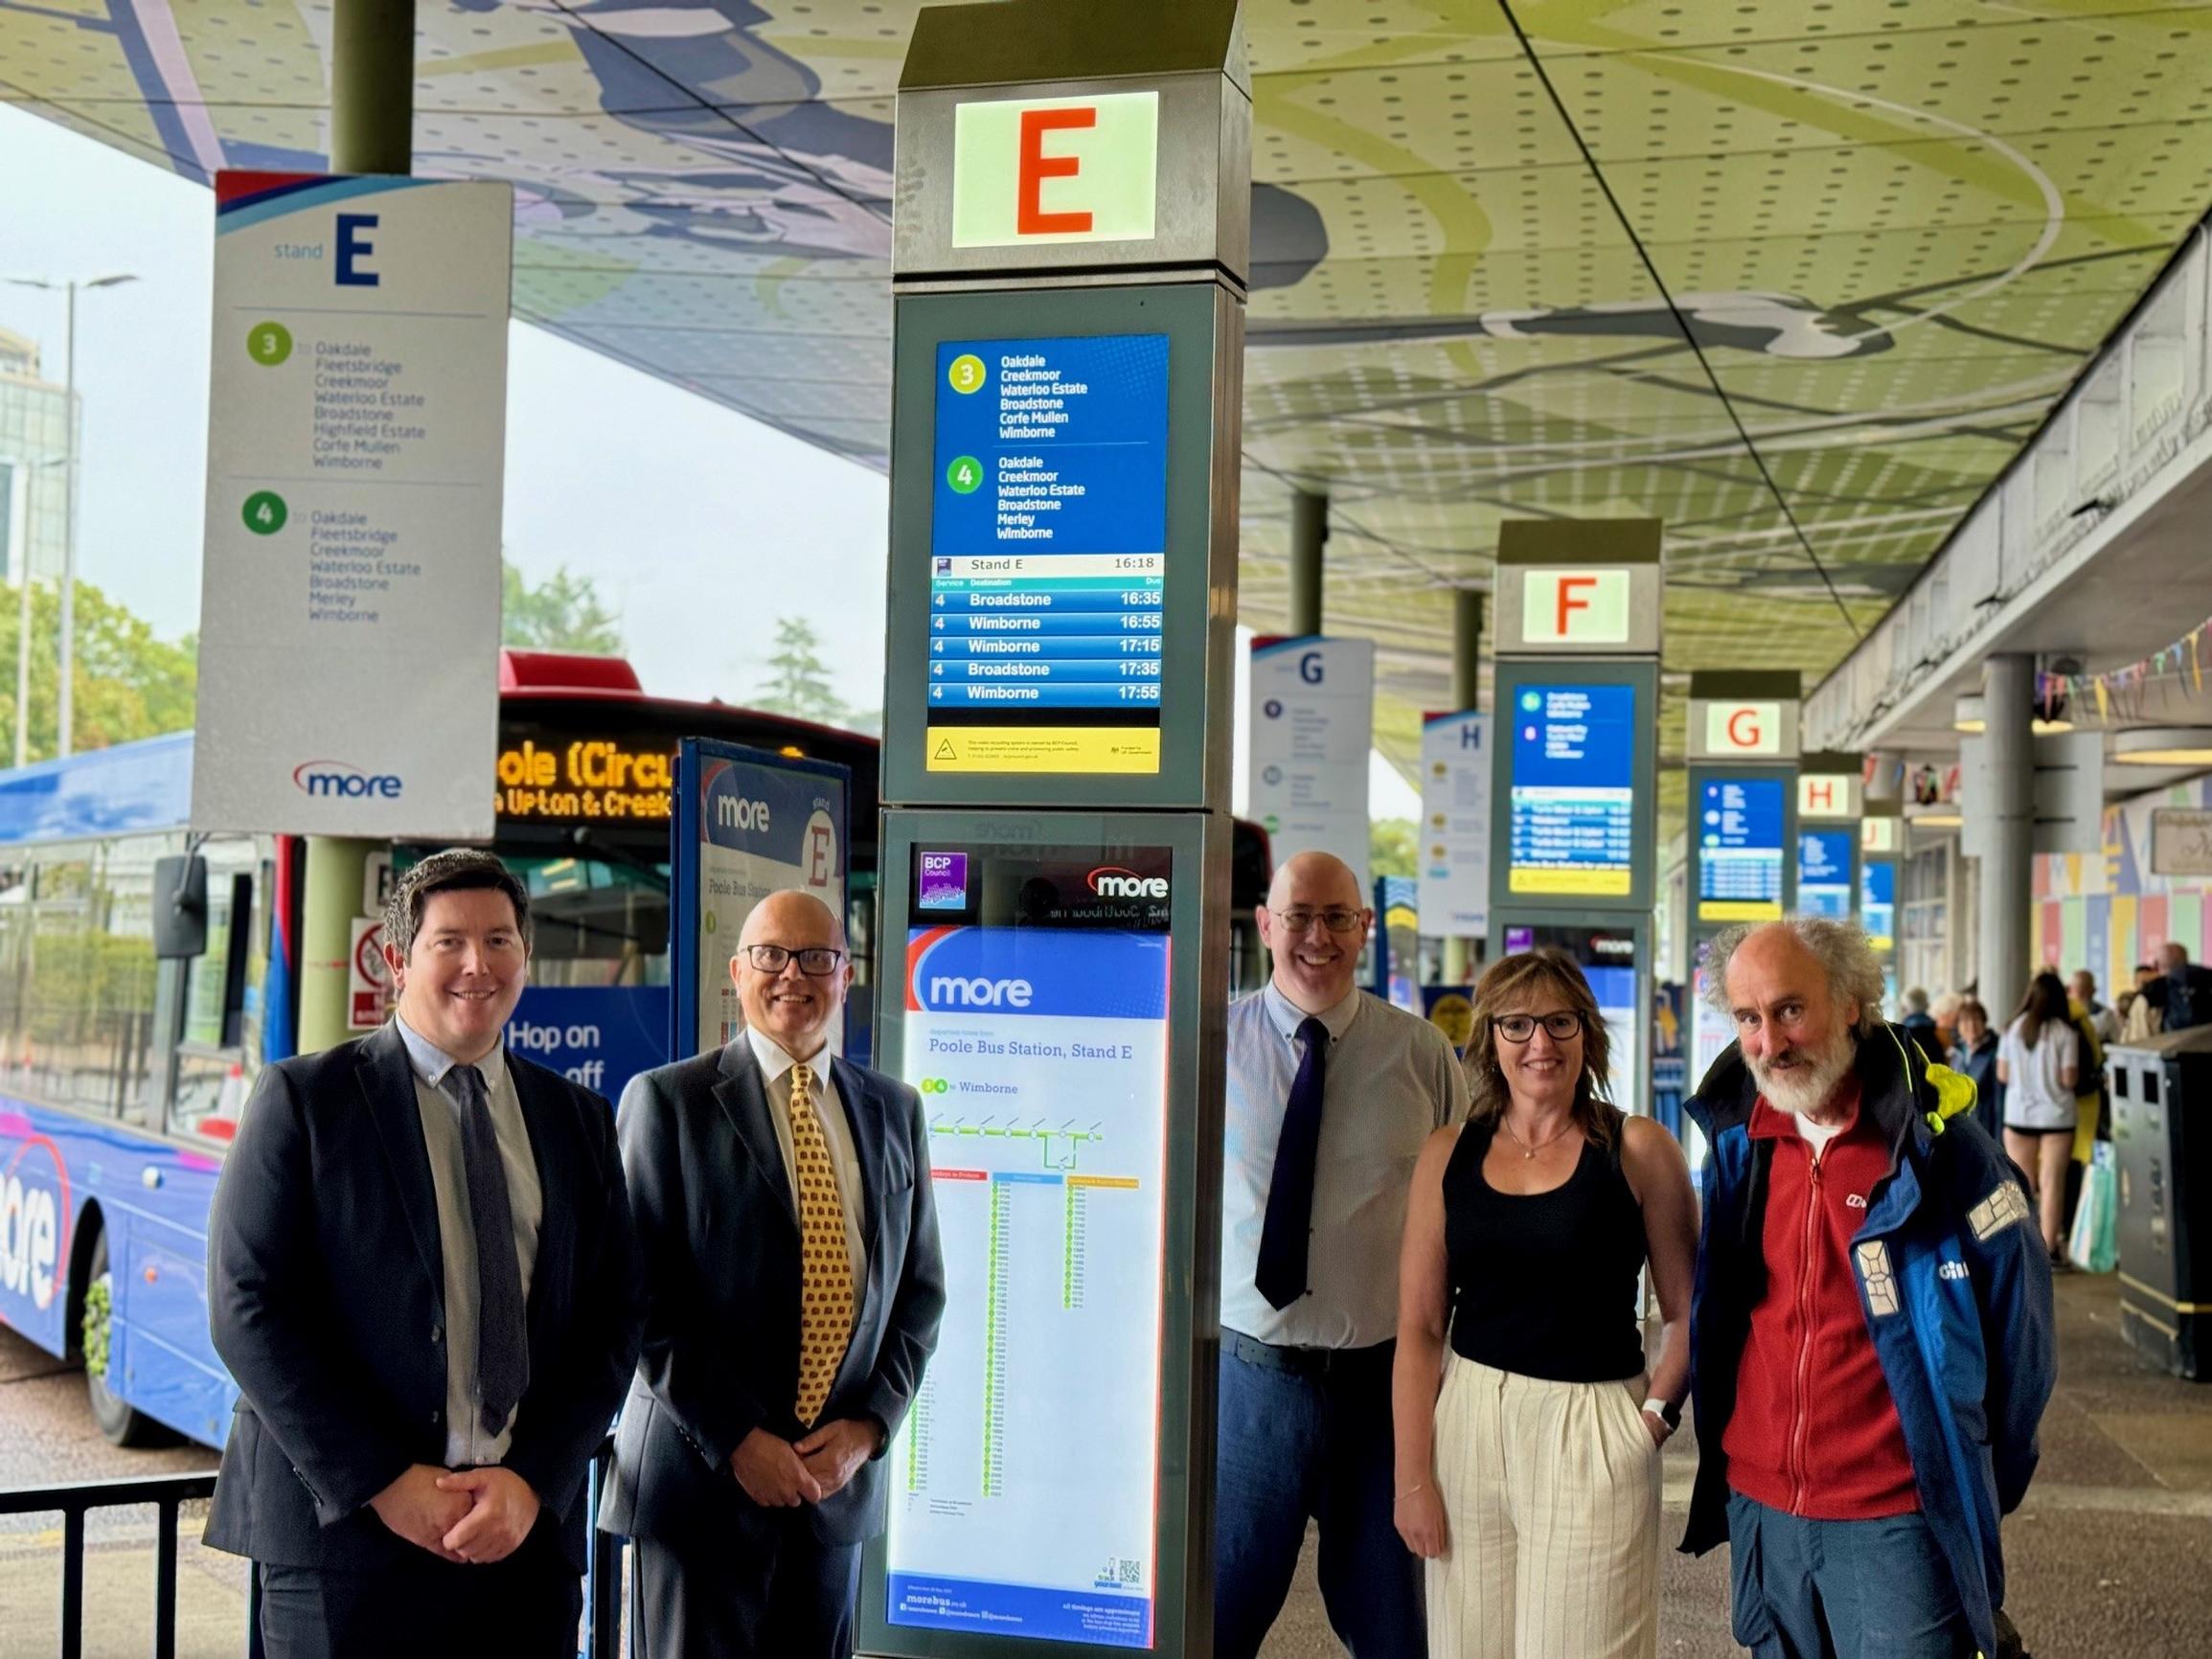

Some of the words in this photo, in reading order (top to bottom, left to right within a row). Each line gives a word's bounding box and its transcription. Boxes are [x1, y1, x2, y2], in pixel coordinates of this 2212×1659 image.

[1017, 107, 1096, 235] E
[275, 242, 323, 260] stand
[335, 213, 378, 286] E
[263, 333, 277, 354] 3
[316, 341, 371, 356] Oakdale
[315, 360, 401, 375] Fleetsbridge
[1000, 355, 1046, 368] Oakdale
[315, 375, 388, 388] Creekmoor
[961, 364, 973, 385] 3
[1000, 370, 1060, 382] Creekmoor
[1000, 384, 1050, 397] Waterloo
[1052, 383, 1087, 395] Estate
[314, 391, 376, 405] Waterloo
[380, 392, 424, 406] Estate
[1000, 398, 1063, 410] Broadstone
[314, 406, 393, 421] Broadstone
[999, 413, 1030, 424] Corfe
[1032, 412, 1069, 423] Mullen
[314, 423, 376, 438] Highfield
[381, 425, 424, 439] Estate
[999, 427, 1056, 439] Wimborne
[313, 439, 350, 453] Corfe
[354, 441, 399, 454] Mullen
[313, 455, 382, 469] Wimborne
[998, 456, 1043, 469] Oakdale
[957, 465, 972, 486] 4
[998, 471, 1059, 483] Creekmoor
[997, 485, 1047, 497] Waterloo
[1049, 484, 1085, 496] Estate
[997, 499, 1061, 511] Broadstone
[257, 502, 273, 525] 4
[311, 511, 367, 525] Oakdale
[997, 513, 1035, 527] Merley
[310, 529, 398, 543] Fleetsbridge
[997, 528, 1053, 539] Wimborne
[310, 543, 384, 557] Creekmoor
[309, 560, 373, 575] Waterloo
[377, 562, 421, 576] Estate
[970, 559, 1010, 570] Stand
[1015, 558, 1023, 569] E
[1114, 557, 1154, 569] 16:18
[309, 576, 389, 590] Broadstone
[309, 591, 355, 608] Merley
[935, 594, 945, 606] 4
[969, 594, 1051, 606] Broadstone
[1121, 592, 1161, 605] 16:35
[1557, 578, 1597, 635] F
[308, 608, 378, 623] Wimborne
[935, 617, 945, 629] 4
[969, 617, 1040, 629] Wimborne
[1120, 615, 1160, 628] 16:55
[934, 641, 944, 652] 4
[969, 640, 1040, 652] Wimborne
[1119, 639, 1160, 652] 17:15
[933, 664, 944, 675] 4
[968, 663, 1050, 676] Broadstone
[1119, 662, 1159, 675] 17:35
[1300, 652, 1323, 685] G
[933, 688, 943, 699] 4
[968, 687, 1039, 699] Wimborne
[1118, 686, 1158, 699] 17:55
[1727, 710, 1761, 747] G
[1462, 725, 1480, 748] H
[308, 772, 402, 797] more
[508, 789, 579, 814] Upton
[582, 790, 601, 815] &
[1808, 782, 1833, 808] H
[718, 795, 770, 831] more
[1863, 824, 1877, 845] J
[809, 826, 831, 887] E
[924, 857, 950, 869] BCP
[709, 878, 731, 896] Poole
[733, 881, 746, 897] Bus
[1098, 875, 1168, 898] more
[931, 977, 1033, 1007] more
[509, 1021, 561, 1055] Hop
[565, 1025, 600, 1049] on
[929, 1038, 972, 1054] Poole
[977, 1040, 1005, 1055] Bus
[1008, 1041, 1067, 1059] Station,
[1071, 1043, 1117, 1058] Stand
[1121, 1045, 1132, 1059] E
[959, 1081, 1018, 1094] Wimborne
